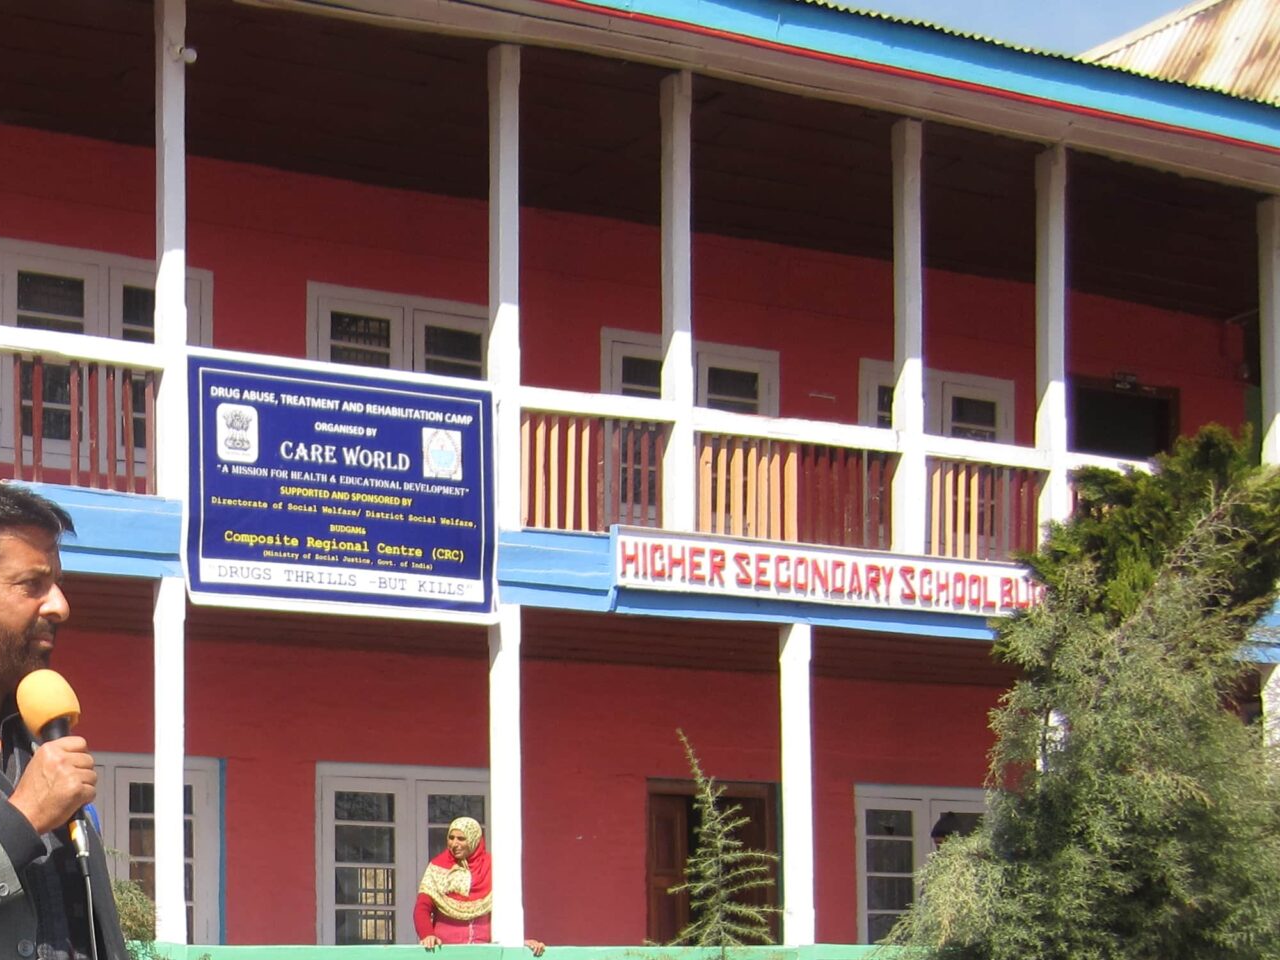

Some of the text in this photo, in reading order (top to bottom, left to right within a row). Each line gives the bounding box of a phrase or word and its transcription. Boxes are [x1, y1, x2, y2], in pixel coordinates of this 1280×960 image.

[210, 386, 473, 425] DRUG ABUSE, TREATMENT AND REHABILITATION CAMP
[314, 422, 377, 437] ORGANISED BY
[280, 441, 410, 471] CARE WORLD
[231, 465, 268, 478] MISSION
[271, 469, 288, 479] FOR
[291, 471, 327, 483] HEALTH
[330, 475, 336, 483] &
[339, 476, 401, 490] EDUCATIONAL
[211, 496, 268, 508] Directorate
[287, 503, 317, 513] Social
[365, 510, 404, 521] District
[408, 514, 436, 524] Social
[280, 486, 412, 507] SUPPORTED AND SPONSORED BY
[224, 530, 464, 562] Composite Regional Centre (CRC)
[284, 569, 357, 587] THRILLS
[621, 541, 726, 587] HIGHER
[733, 552, 894, 604] SECONDARY
[899, 565, 996, 613] SCHOOL
